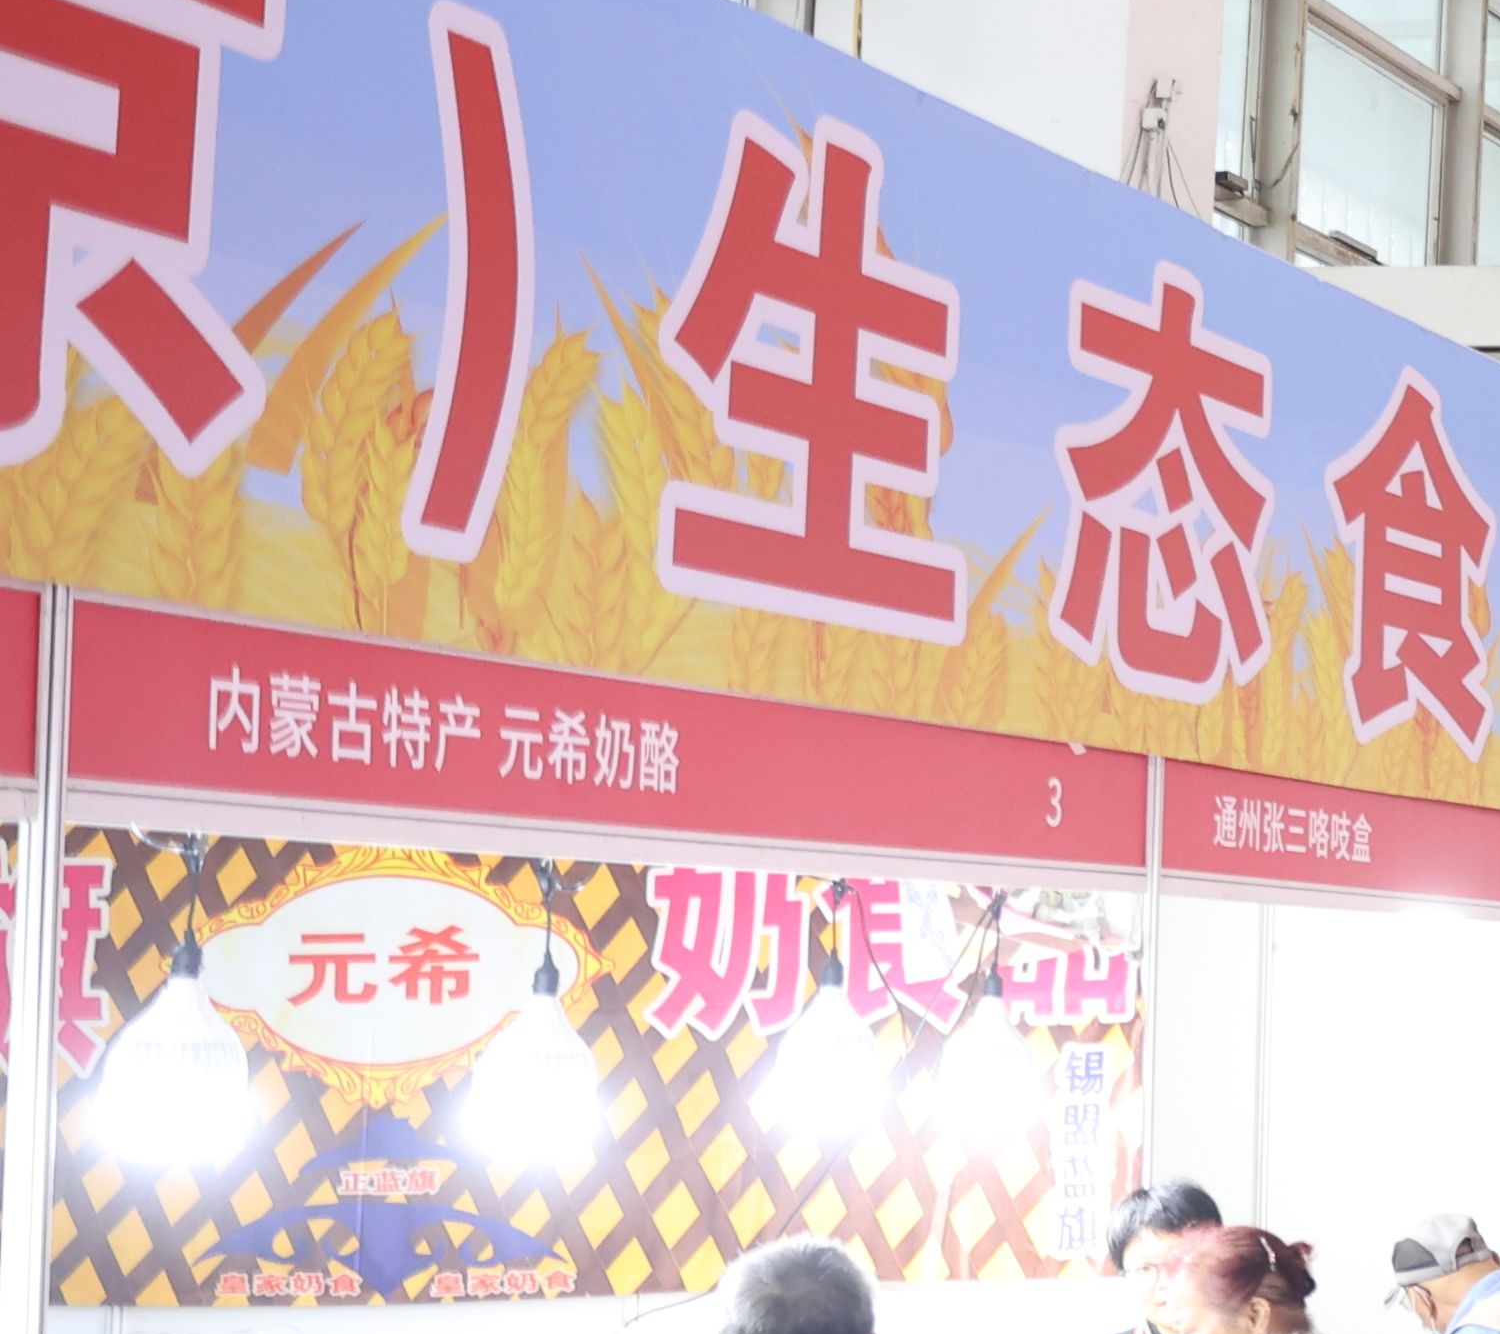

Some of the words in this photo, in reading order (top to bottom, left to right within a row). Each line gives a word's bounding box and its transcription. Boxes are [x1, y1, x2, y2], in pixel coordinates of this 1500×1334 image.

[207, 665, 484, 774] 内蒙古特产
[498, 716, 681, 795] 元希奶酪
[1045, 777, 1063, 828] 3
[1212, 795, 1373, 864] 通州张三咯吱盒
[287, 924, 481, 1006] 元希
[338, 1167, 440, 1196] 正蓝旗
[216, 1271, 363, 1298] 皇家奶食
[430, 1269, 577, 1298] 皇家奶食
